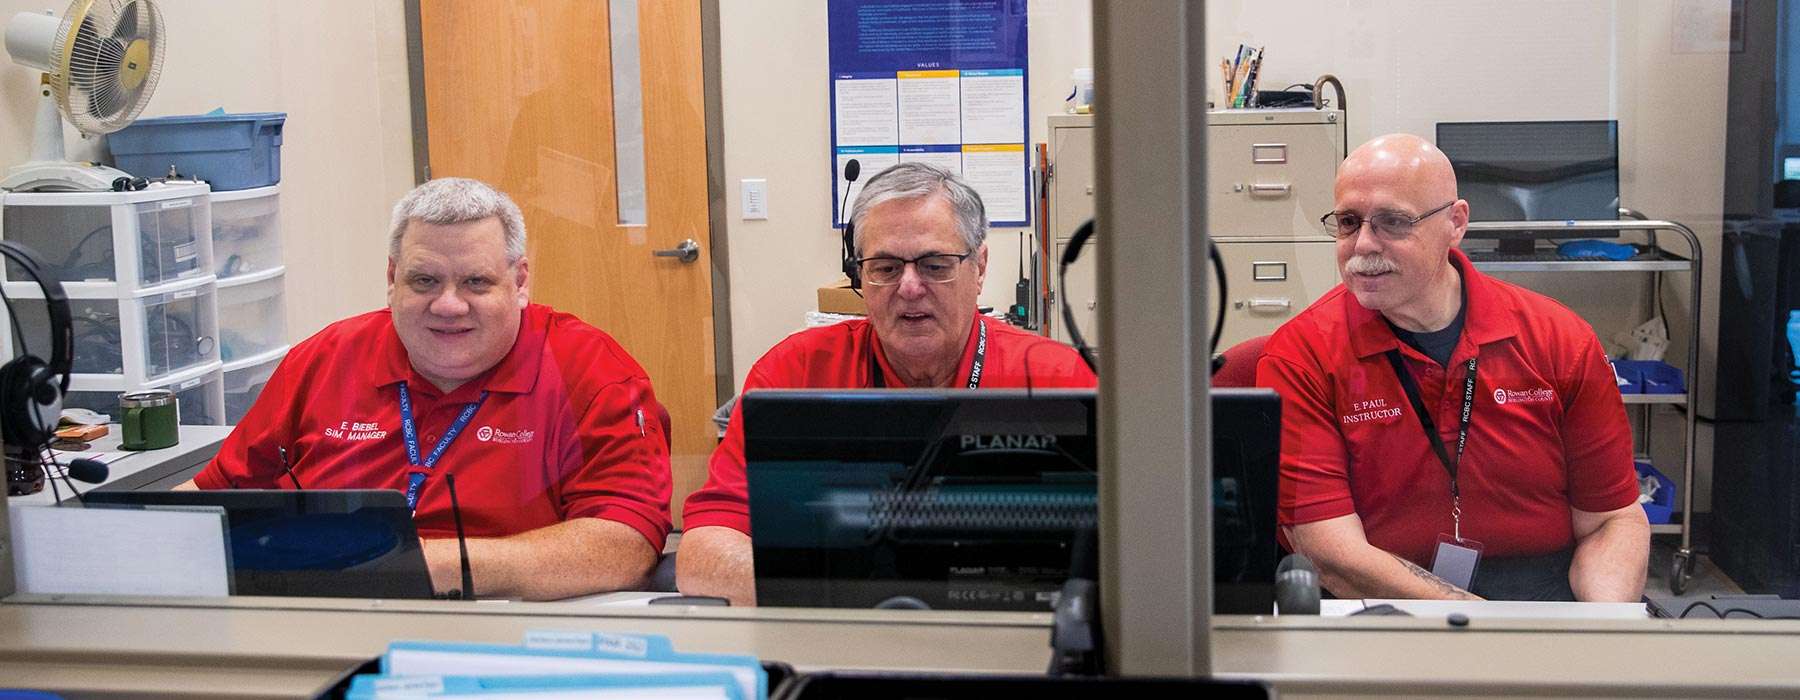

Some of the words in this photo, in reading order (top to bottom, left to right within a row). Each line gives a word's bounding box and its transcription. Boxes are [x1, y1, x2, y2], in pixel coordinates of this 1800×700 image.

[971, 361, 981, 383] STAFF
[1465, 378, 1475, 400] STAFF
[1362, 399, 1387, 410] PAUL
[1462, 402, 1471, 422] RCBC
[1343, 407, 1402, 423] INSTRUCTOR
[352, 422, 379, 431] BIEBEL
[405, 419, 413, 438] RCBC
[347, 431, 387, 440] MANAGER
[433, 427, 457, 456] FACULTY
[961, 434, 1057, 449] PLANAR
